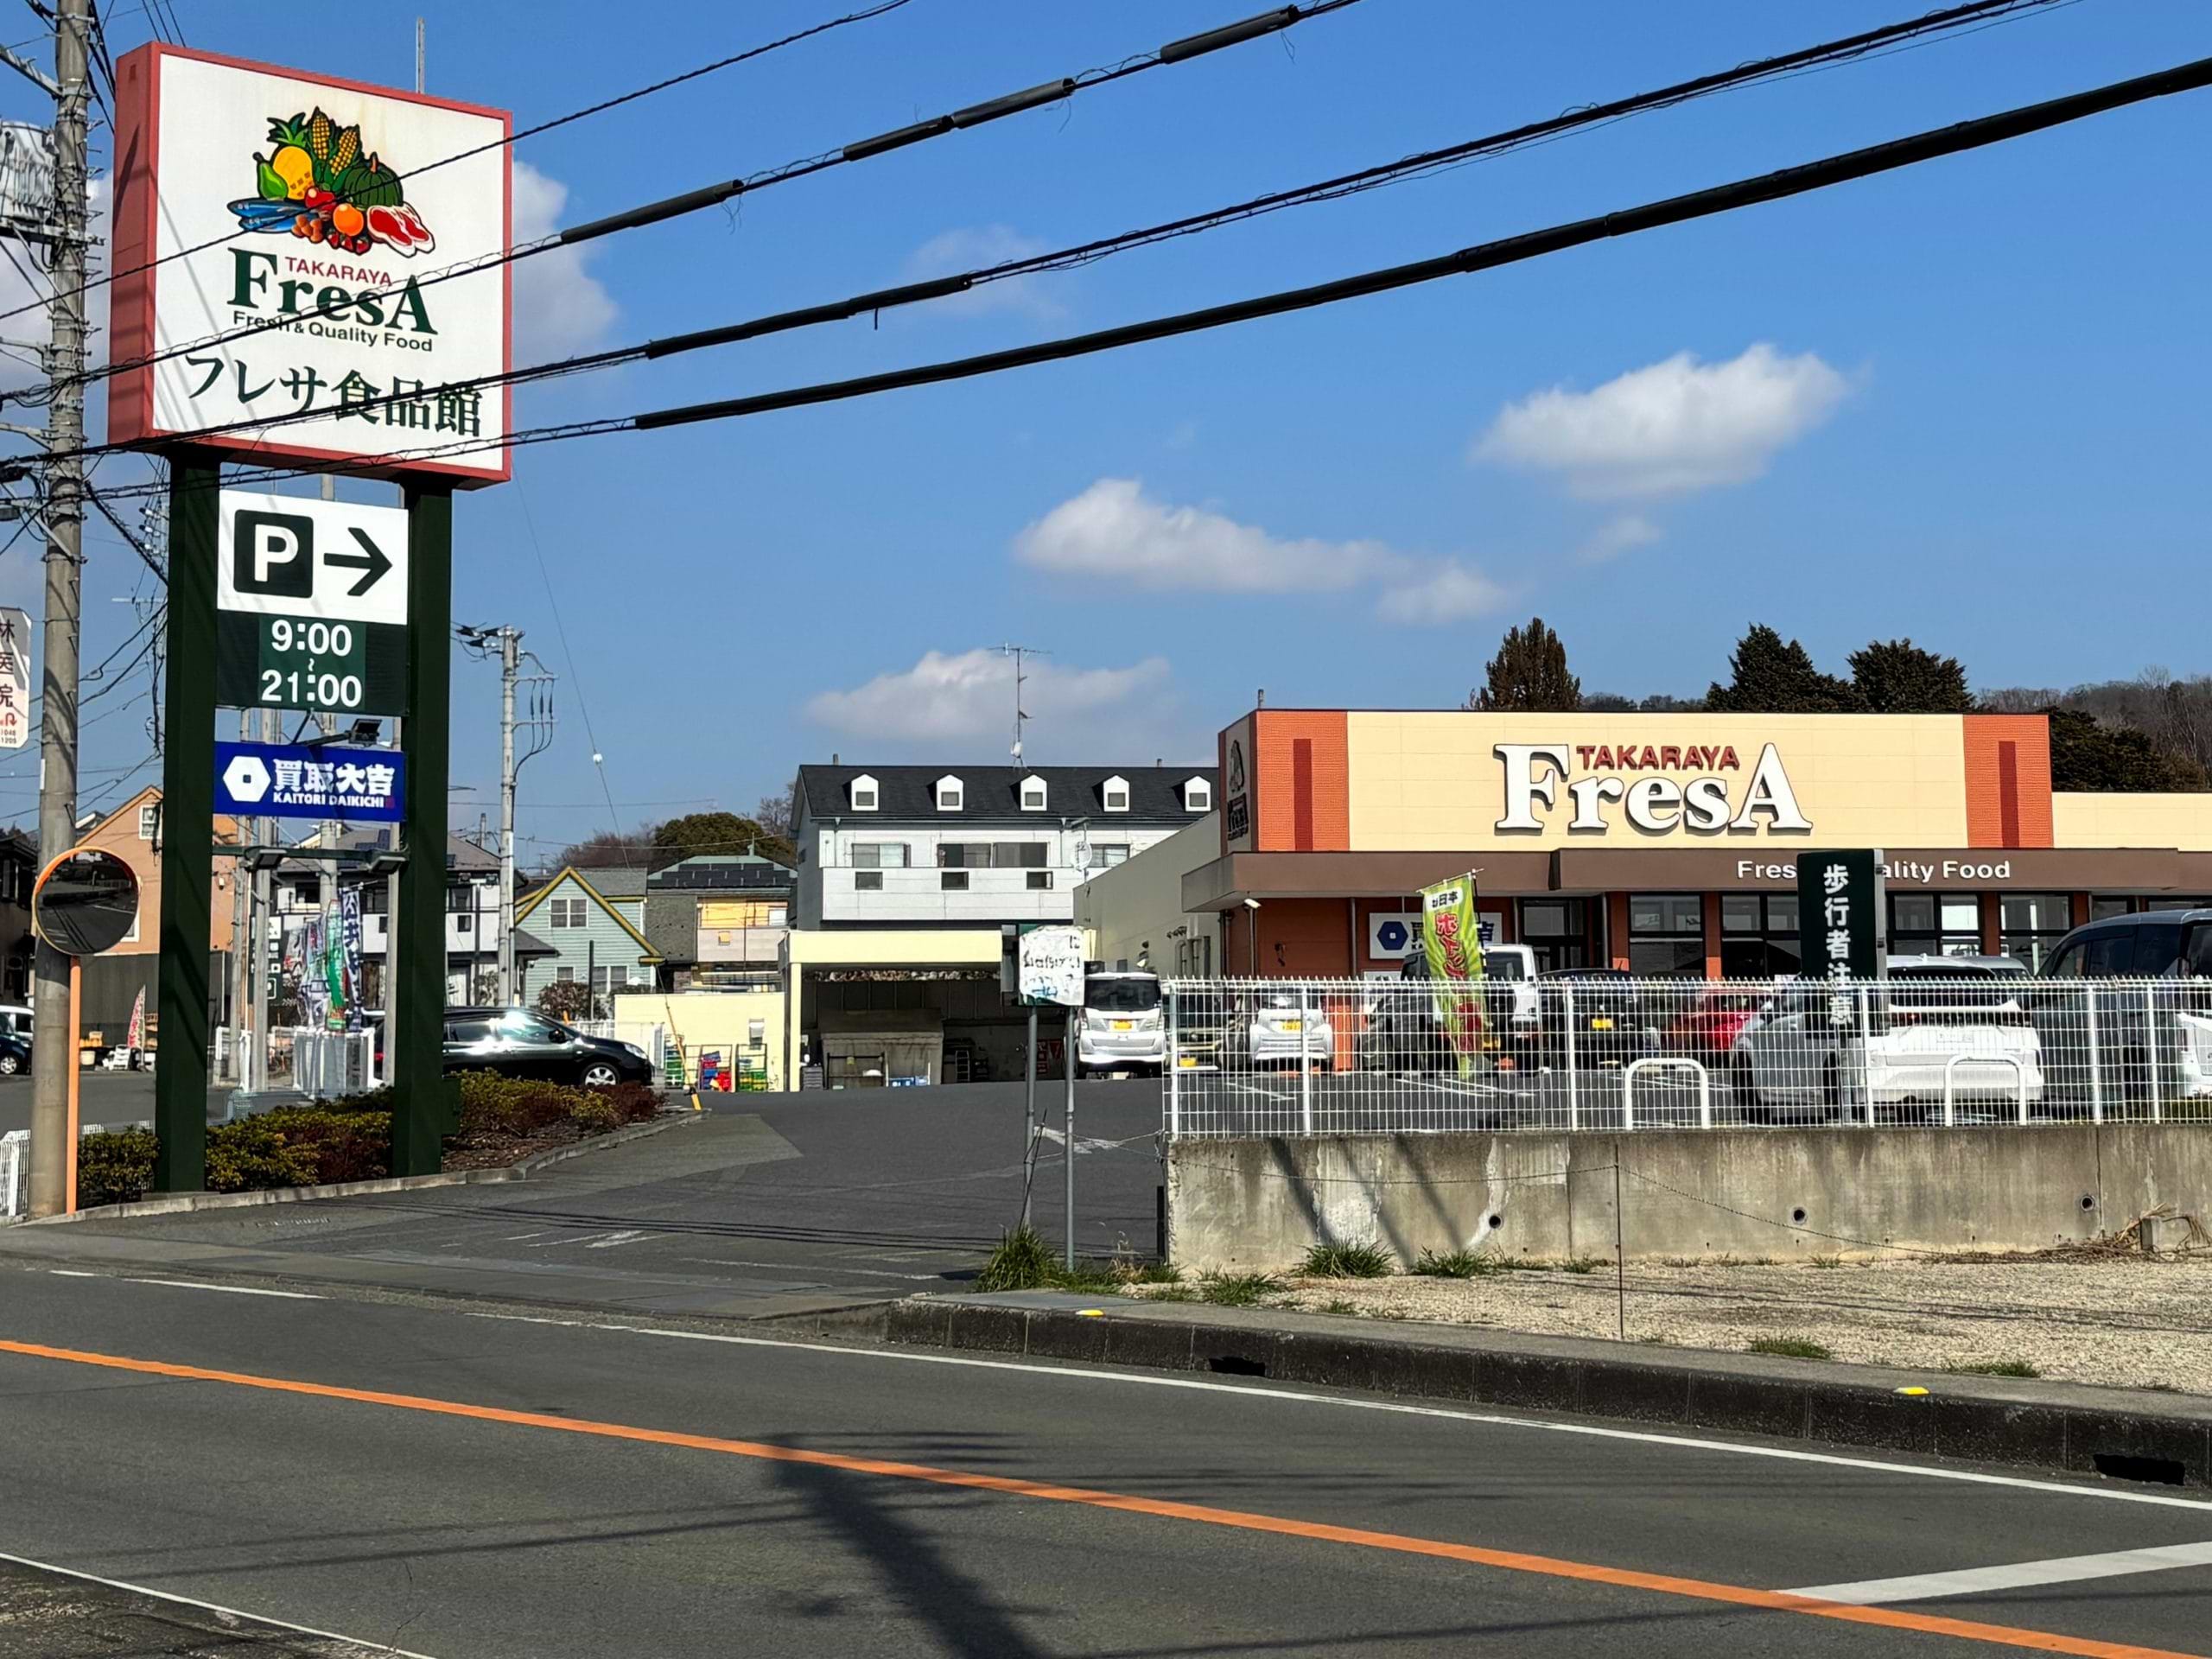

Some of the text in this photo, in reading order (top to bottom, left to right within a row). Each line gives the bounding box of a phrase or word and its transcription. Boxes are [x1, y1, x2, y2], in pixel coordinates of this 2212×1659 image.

[285, 257, 393, 286] TAKARAYA
[227, 247, 438, 335] FresA
[294, 323, 304, 334] &
[308, 322, 378, 346] Quality
[384, 333, 433, 352] Food
[186, 354, 483, 437] フレサ食品館
[254, 524, 299, 582] P
[271, 619, 353, 657] 9:00
[261, 669, 363, 708] 21:00
[1575, 745, 1740, 770] TAKARAYA
[273, 759, 396, 796] 買取大吉
[1493, 741, 1814, 836] FresA
[273, 792, 326, 805] KAITORI
[329, 795, 385, 809] DAIKICHI
[1738, 861, 2012, 883] Fres ality Food
[1822, 863, 1853, 1026] 歩行者注意
